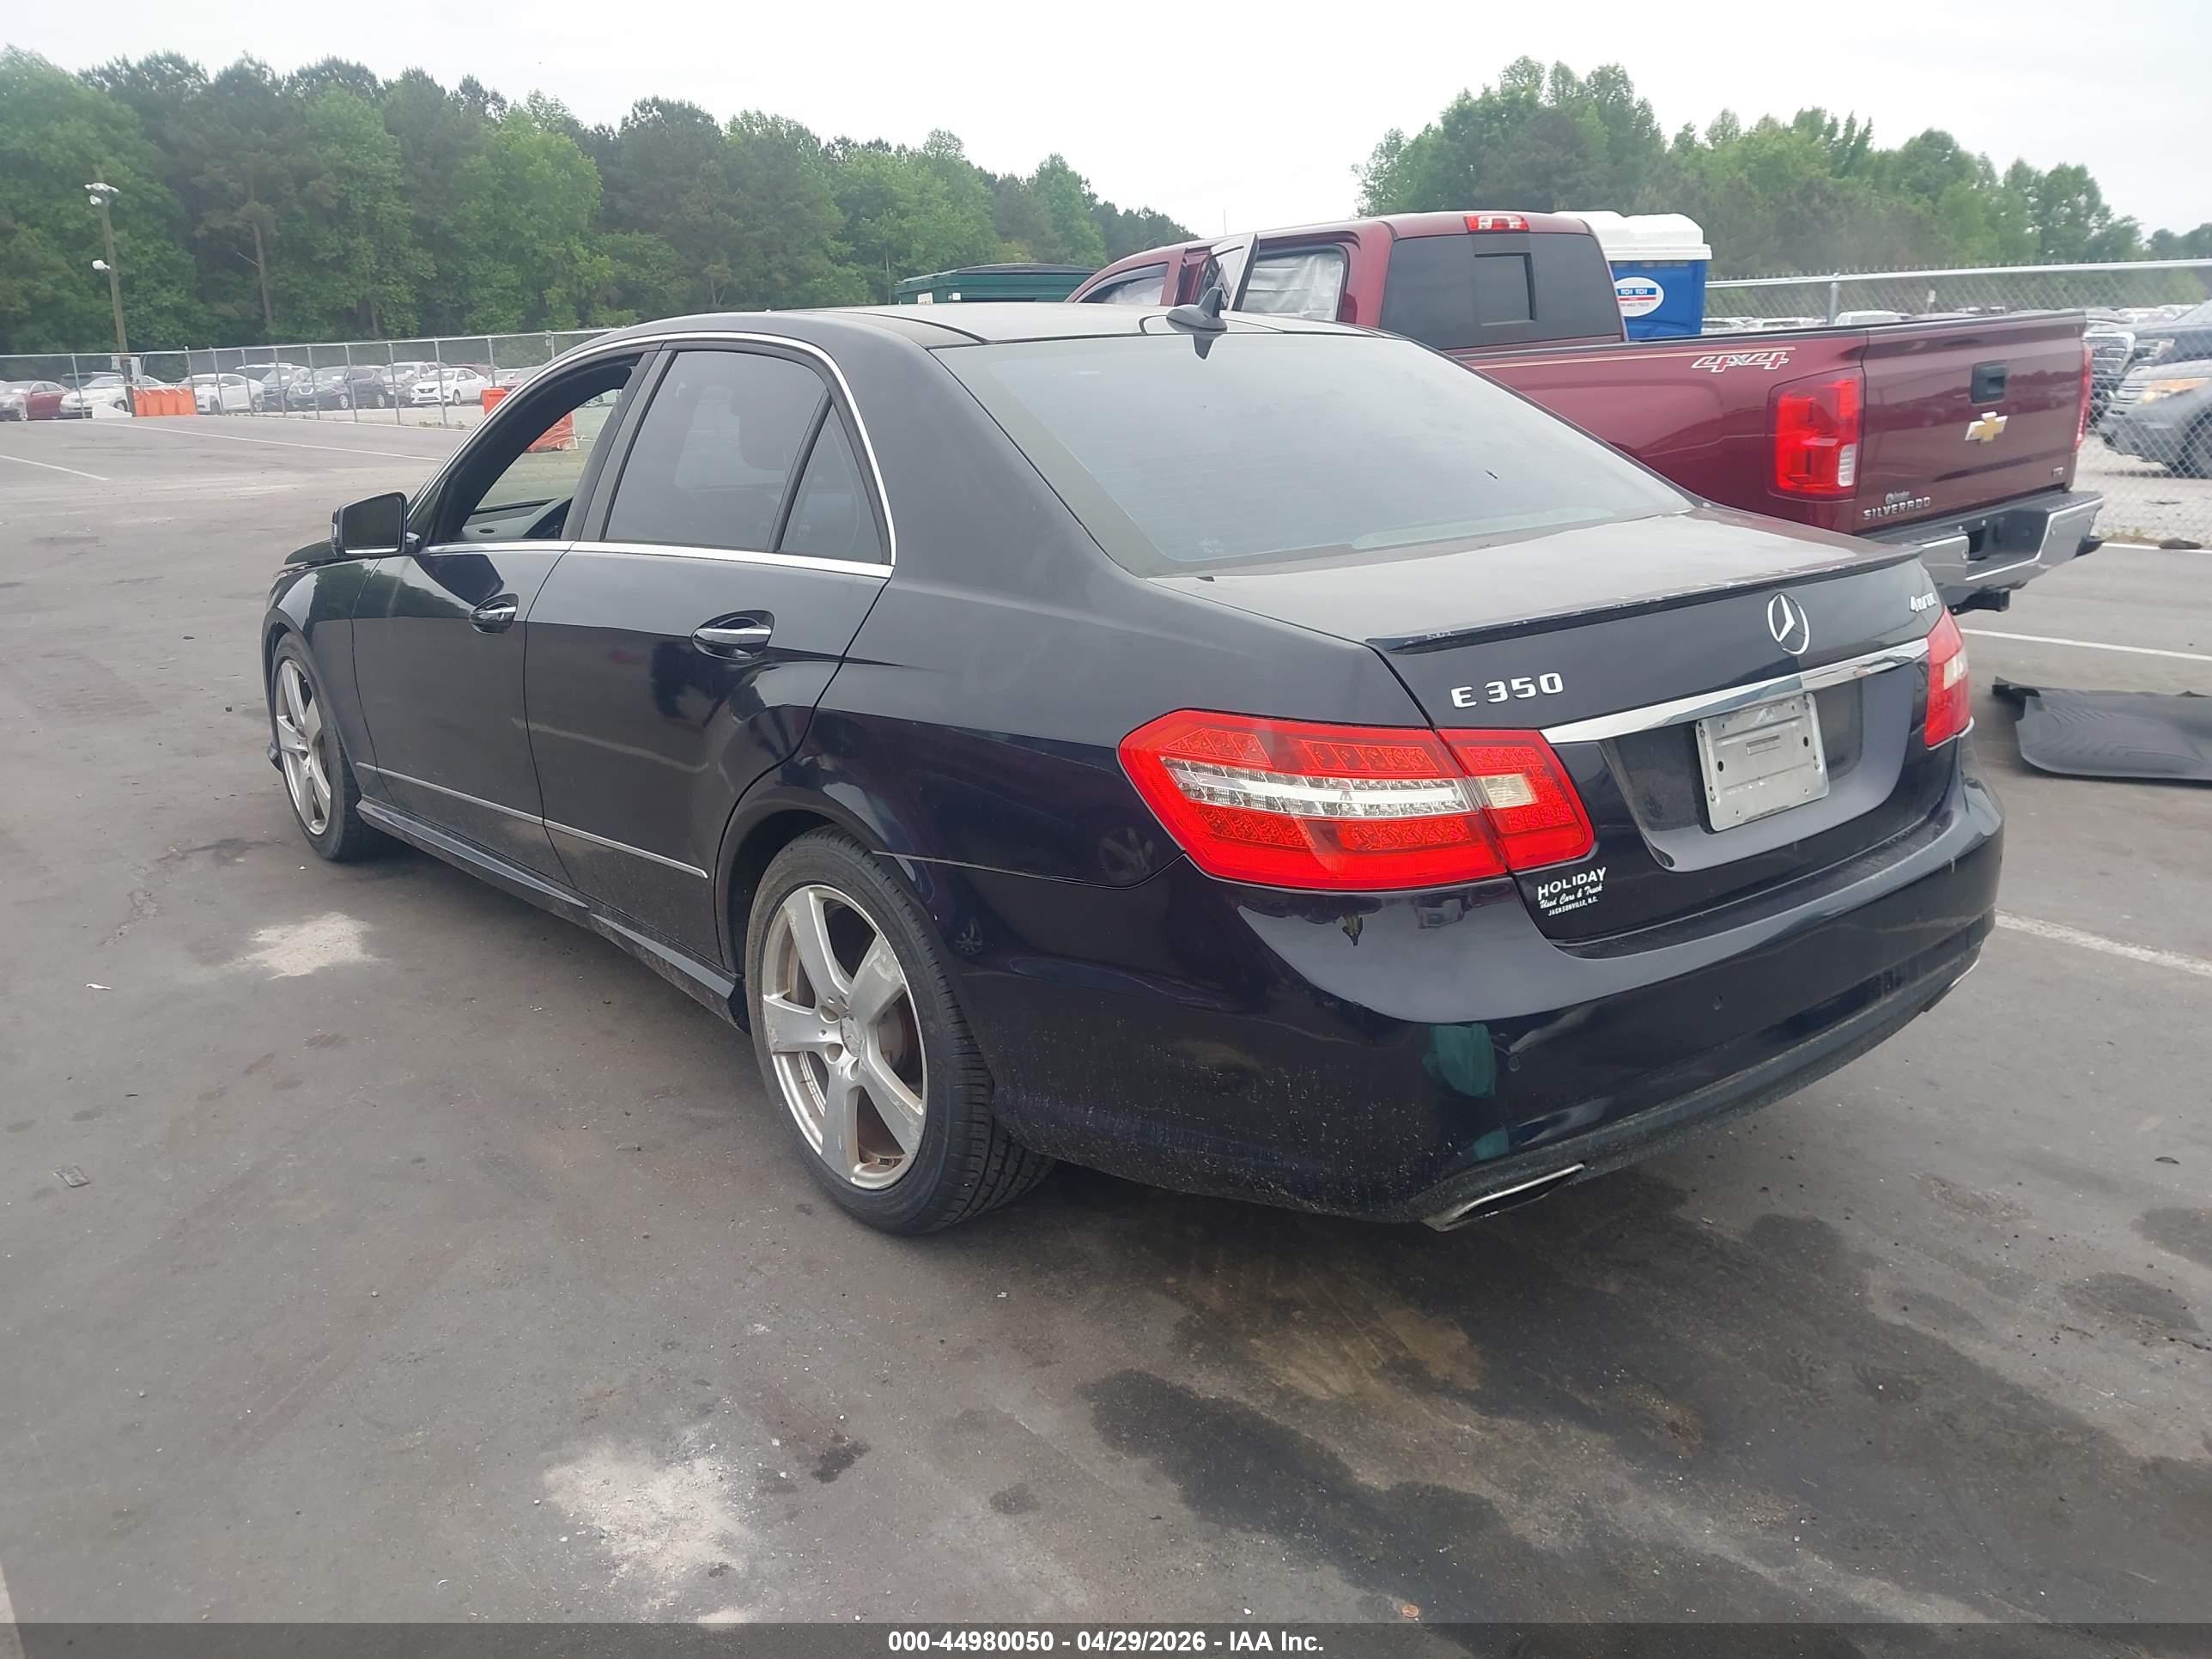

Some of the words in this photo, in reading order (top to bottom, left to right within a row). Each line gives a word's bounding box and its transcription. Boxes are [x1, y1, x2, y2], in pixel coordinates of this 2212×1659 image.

[1863, 496, 1931, 520] SILVERADO
[1451, 686, 1477, 708] E
[1484, 672, 1564, 702] 350
[1538, 867, 1607, 901] HOLIDAY
[1540, 897, 1558, 909] Used
[1559, 893, 1576, 905] Cars
